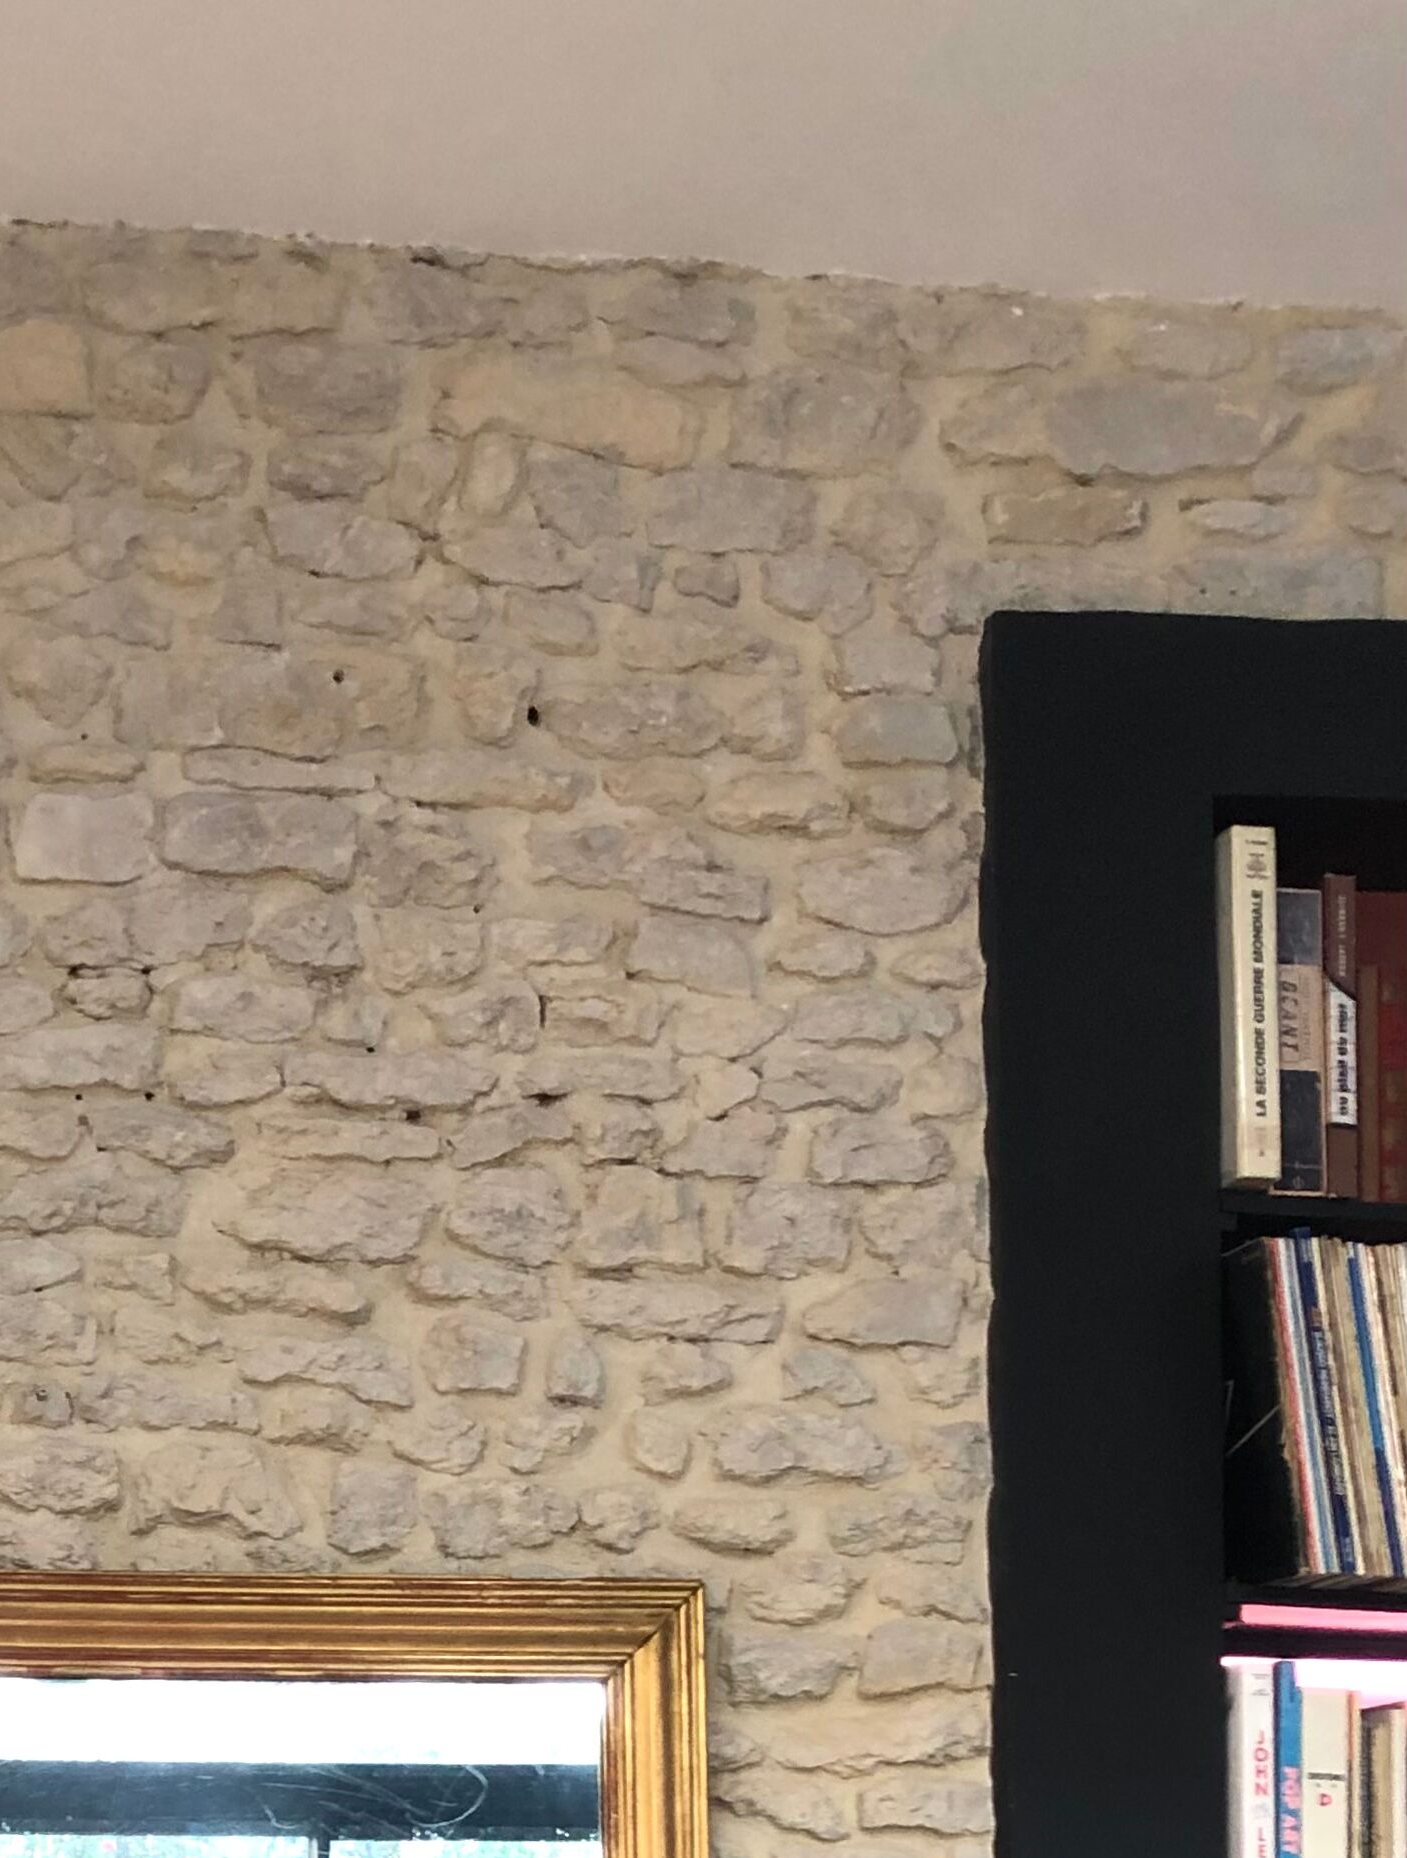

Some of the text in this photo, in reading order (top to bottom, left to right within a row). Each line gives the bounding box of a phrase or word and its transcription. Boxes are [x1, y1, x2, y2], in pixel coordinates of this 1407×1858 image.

[1251, 889, 1267, 1117] LA SECONDE GUERRE MONDIALE
[1254, 1729, 1269, 1796] JOHN
[1280, 1766, 1301, 1854] POP ART
